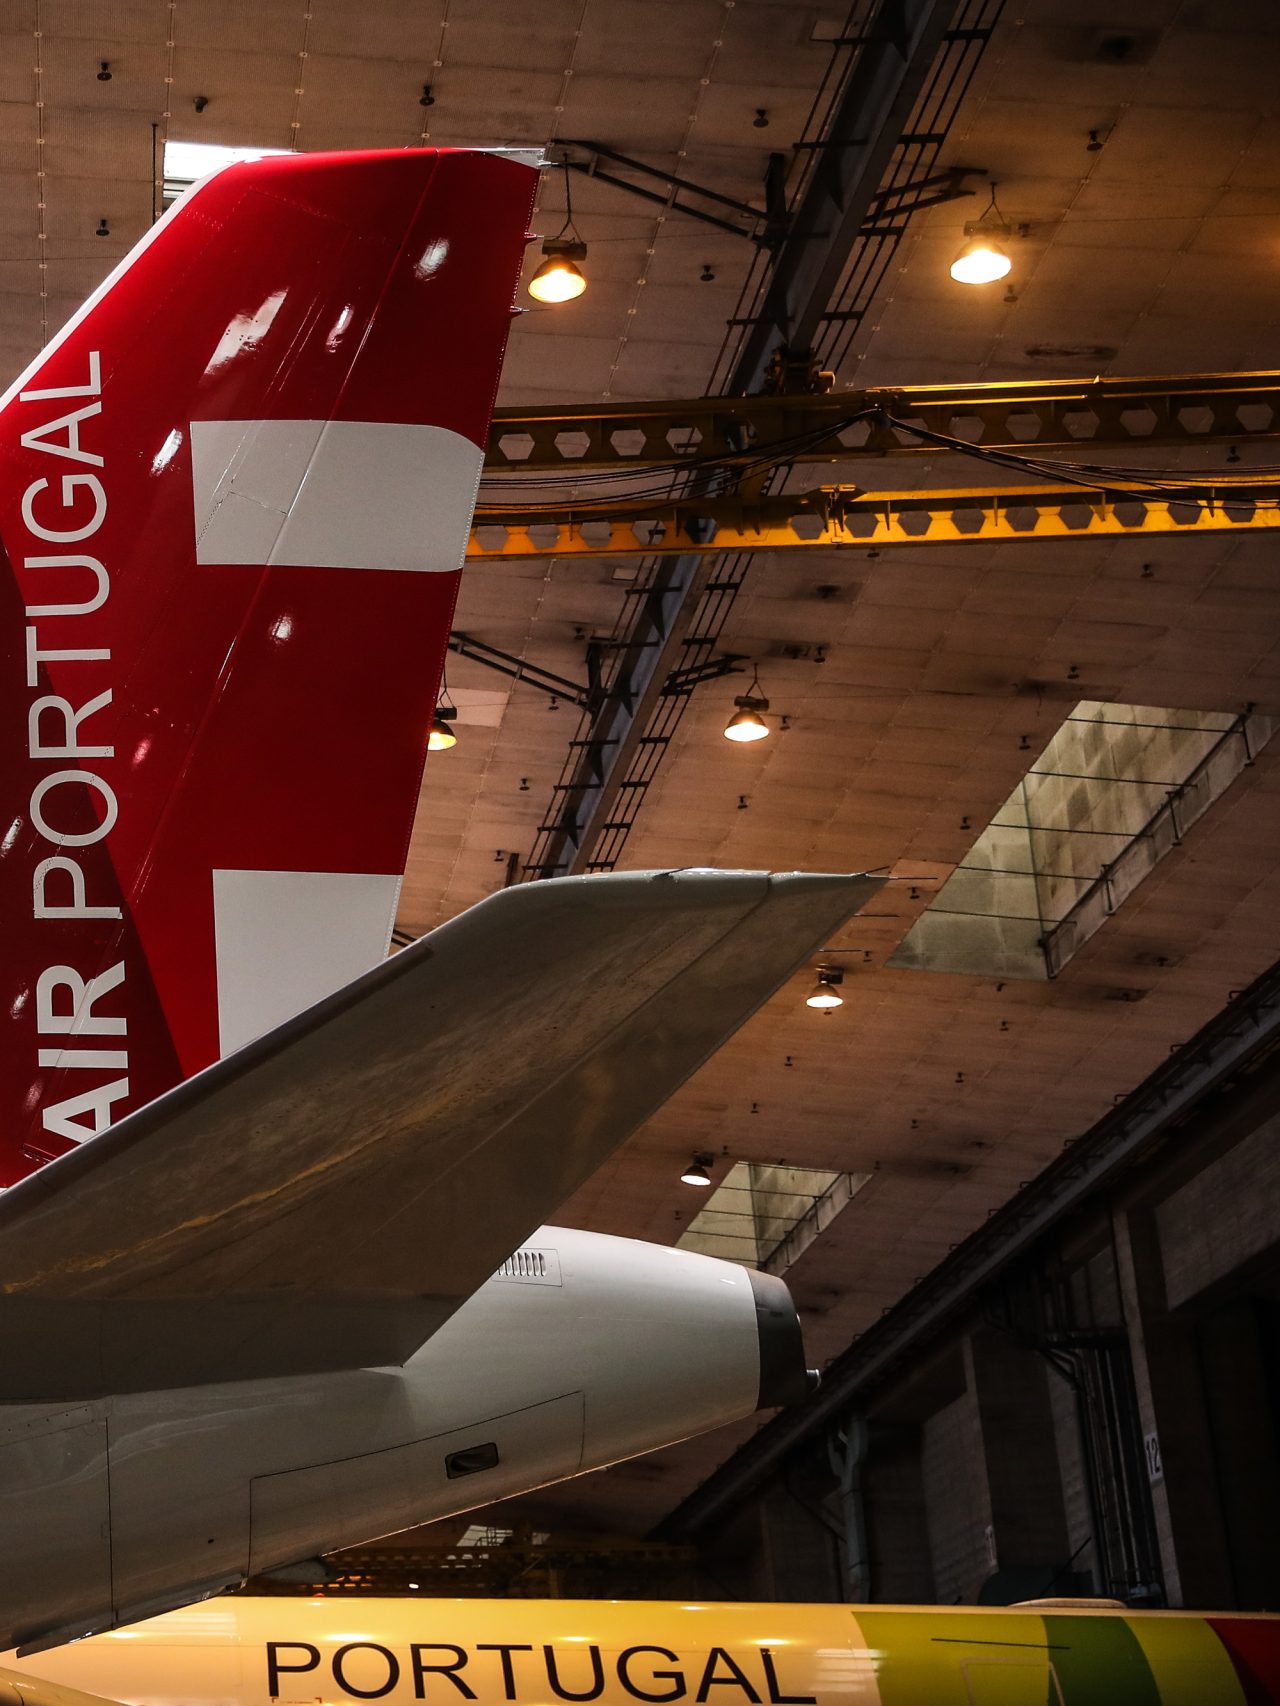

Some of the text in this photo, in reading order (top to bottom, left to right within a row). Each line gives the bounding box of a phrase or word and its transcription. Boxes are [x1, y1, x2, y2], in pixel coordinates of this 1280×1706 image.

[19, 350, 130, 1145] AIR PORTUGAL
[1146, 1437, 1161, 1475] 12
[266, 1641, 818, 1705] PORTUGAL
